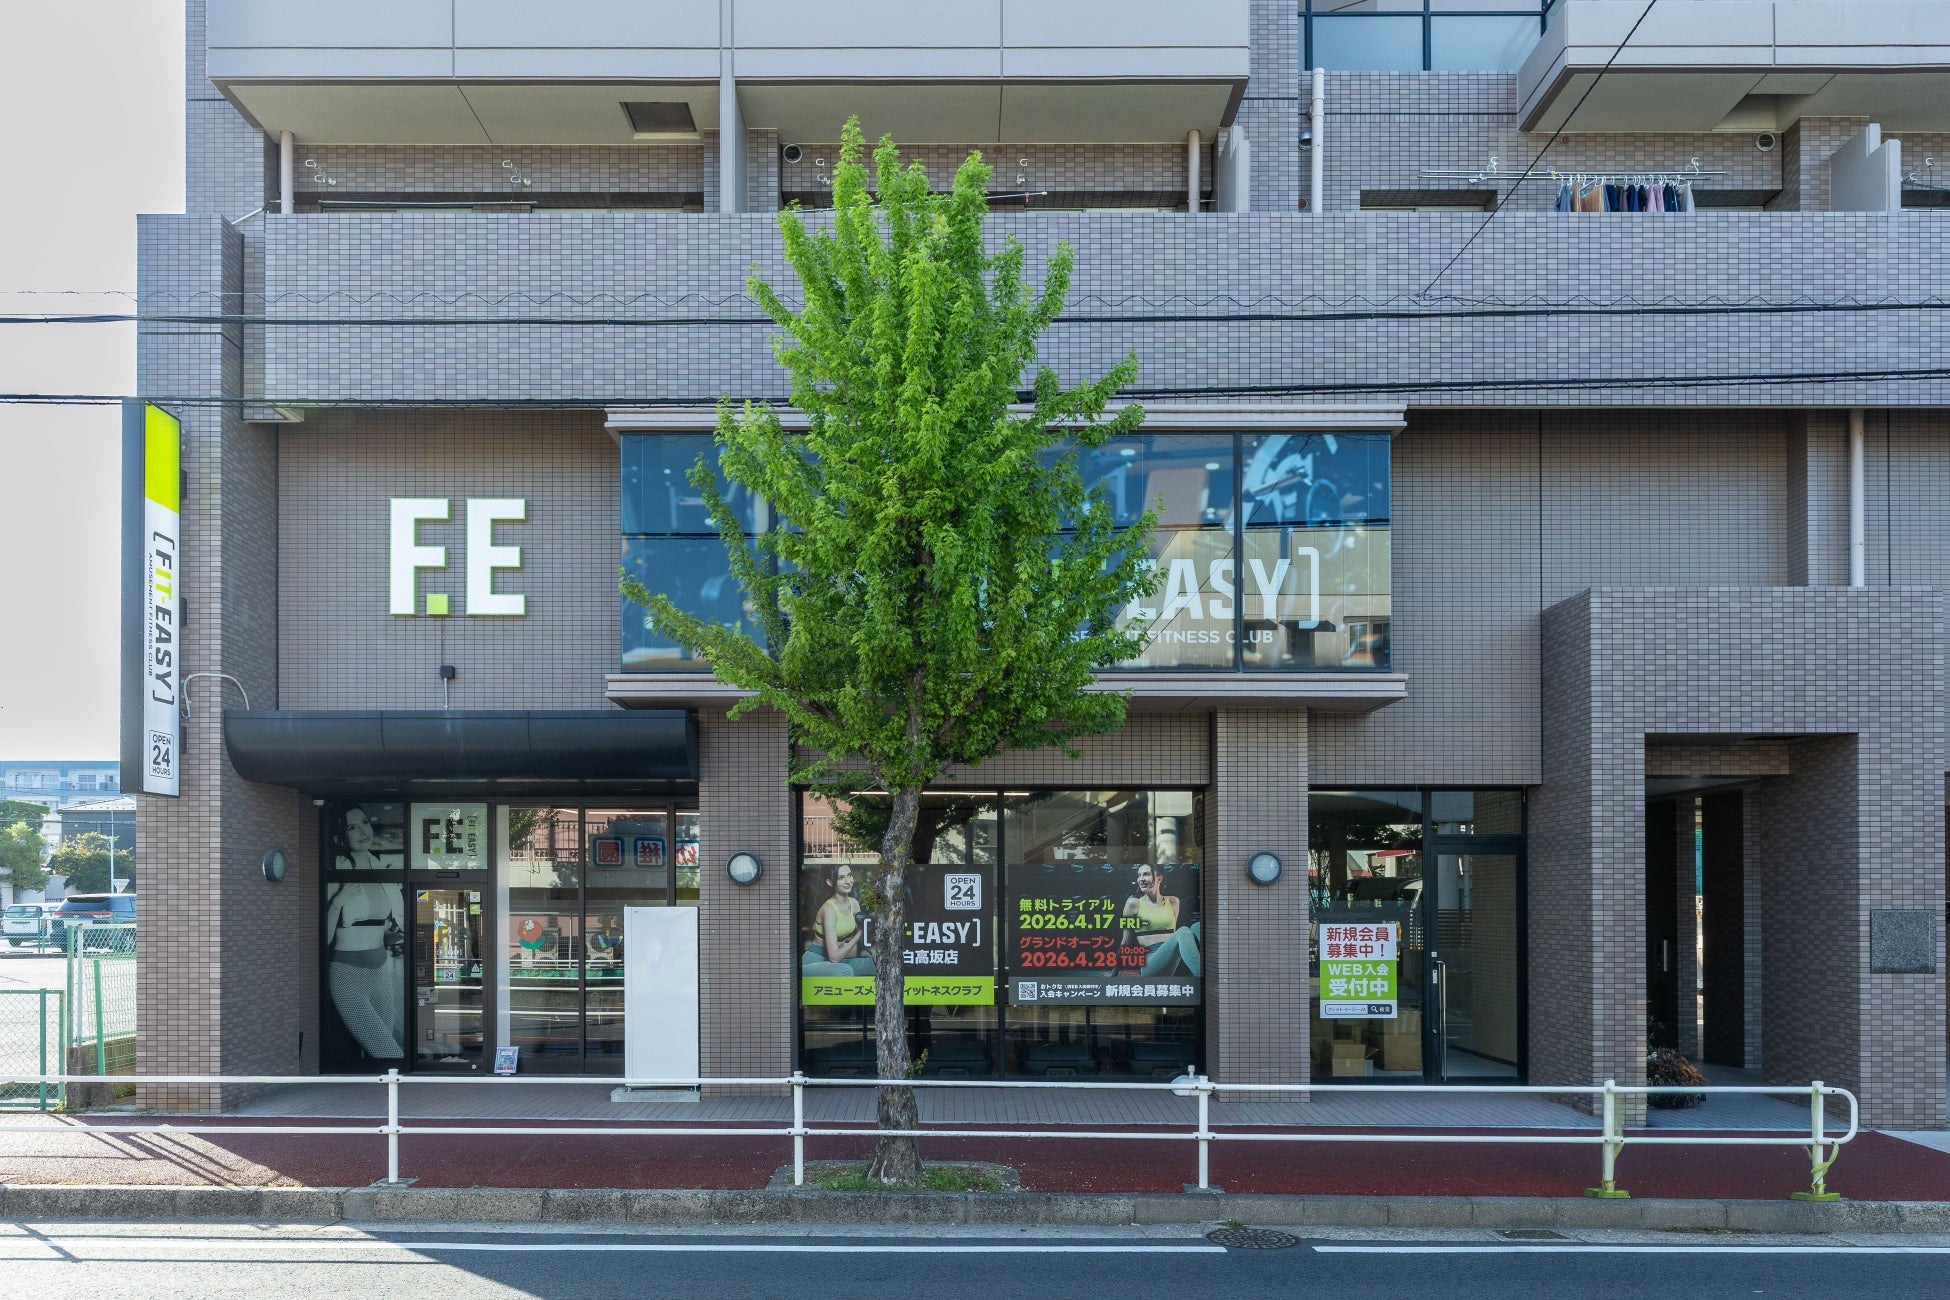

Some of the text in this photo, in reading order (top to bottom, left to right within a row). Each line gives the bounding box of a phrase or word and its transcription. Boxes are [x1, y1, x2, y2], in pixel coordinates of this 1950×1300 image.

[389, 497, 526, 616] F.E
[1126, 547, 1320, 630] EASY]
[153, 531, 175, 706] [FIT-EASY]
[1147, 630, 1220, 644] FITNESS
[152, 734, 171, 745] OPEN
[152, 744, 171, 767] 24
[152, 766, 171, 776] HOURS
[950, 886, 976, 901] 24
[1019, 899, 1115, 911] 無料トライアル
[1019, 914, 1115, 929] 2026.4.17
[863, 918, 981, 947] [-EASY]
[1326, 926, 1390, 942] 新規会員
[1019, 936, 1115, 949] グランドオープン
[902, 950, 959, 965] 白高坂店
[1021, 952, 1145, 967] 2026.4.28 TUE
[813, 986, 983, 997] アミューズメィットネスクラブ
[1039, 990, 1101, 998] 入会キャンペーン
[1105, 984, 1195, 998] 新規会員募集中
[1328, 978, 1389, 997] 受付中
